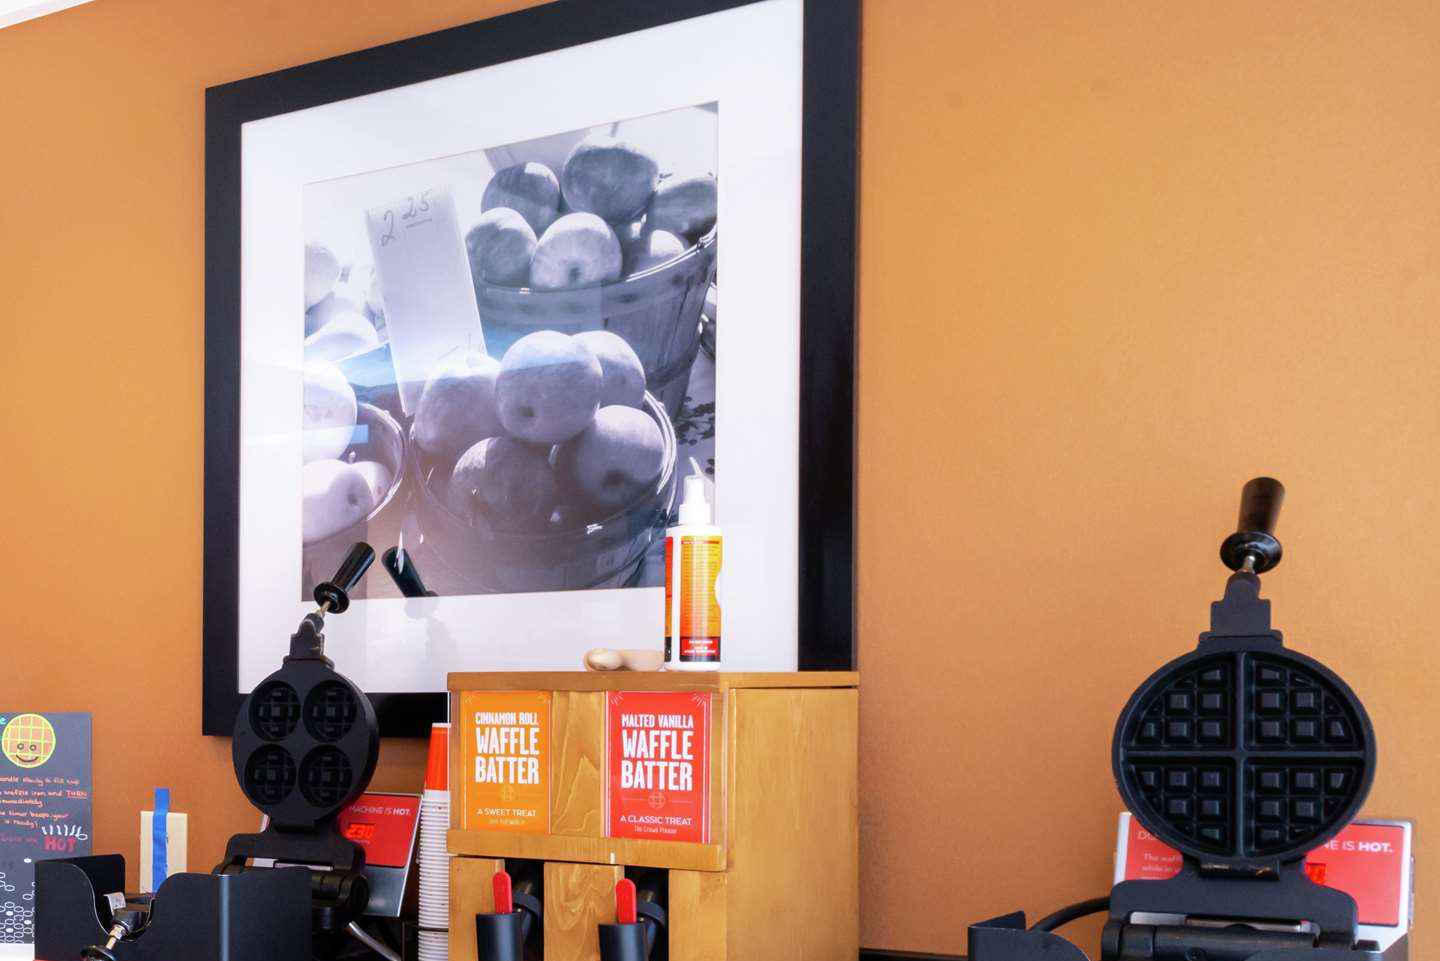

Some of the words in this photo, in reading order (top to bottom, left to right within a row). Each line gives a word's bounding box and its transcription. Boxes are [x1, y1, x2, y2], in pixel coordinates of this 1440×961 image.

[475, 712, 516, 725] CINNAMON
[519, 712, 538, 725] ROLL
[621, 714, 655, 728] MALTED
[658, 714, 694, 729] VANILLA
[475, 727, 540, 755] WAFFLE
[621, 729, 694, 760] WAFFLE
[475, 756, 539, 784] BATTER
[620, 760, 693, 791] BATTER
[484, 808, 510, 816] SWEET
[512, 808, 536, 817] TREAT
[620, 815, 627, 823] A
[627, 815, 663, 824] CLASSIC
[665, 816, 692, 825] TREAT
[1342, 841, 1355, 851] IS
[1358, 842, 1393, 853] HOT.
